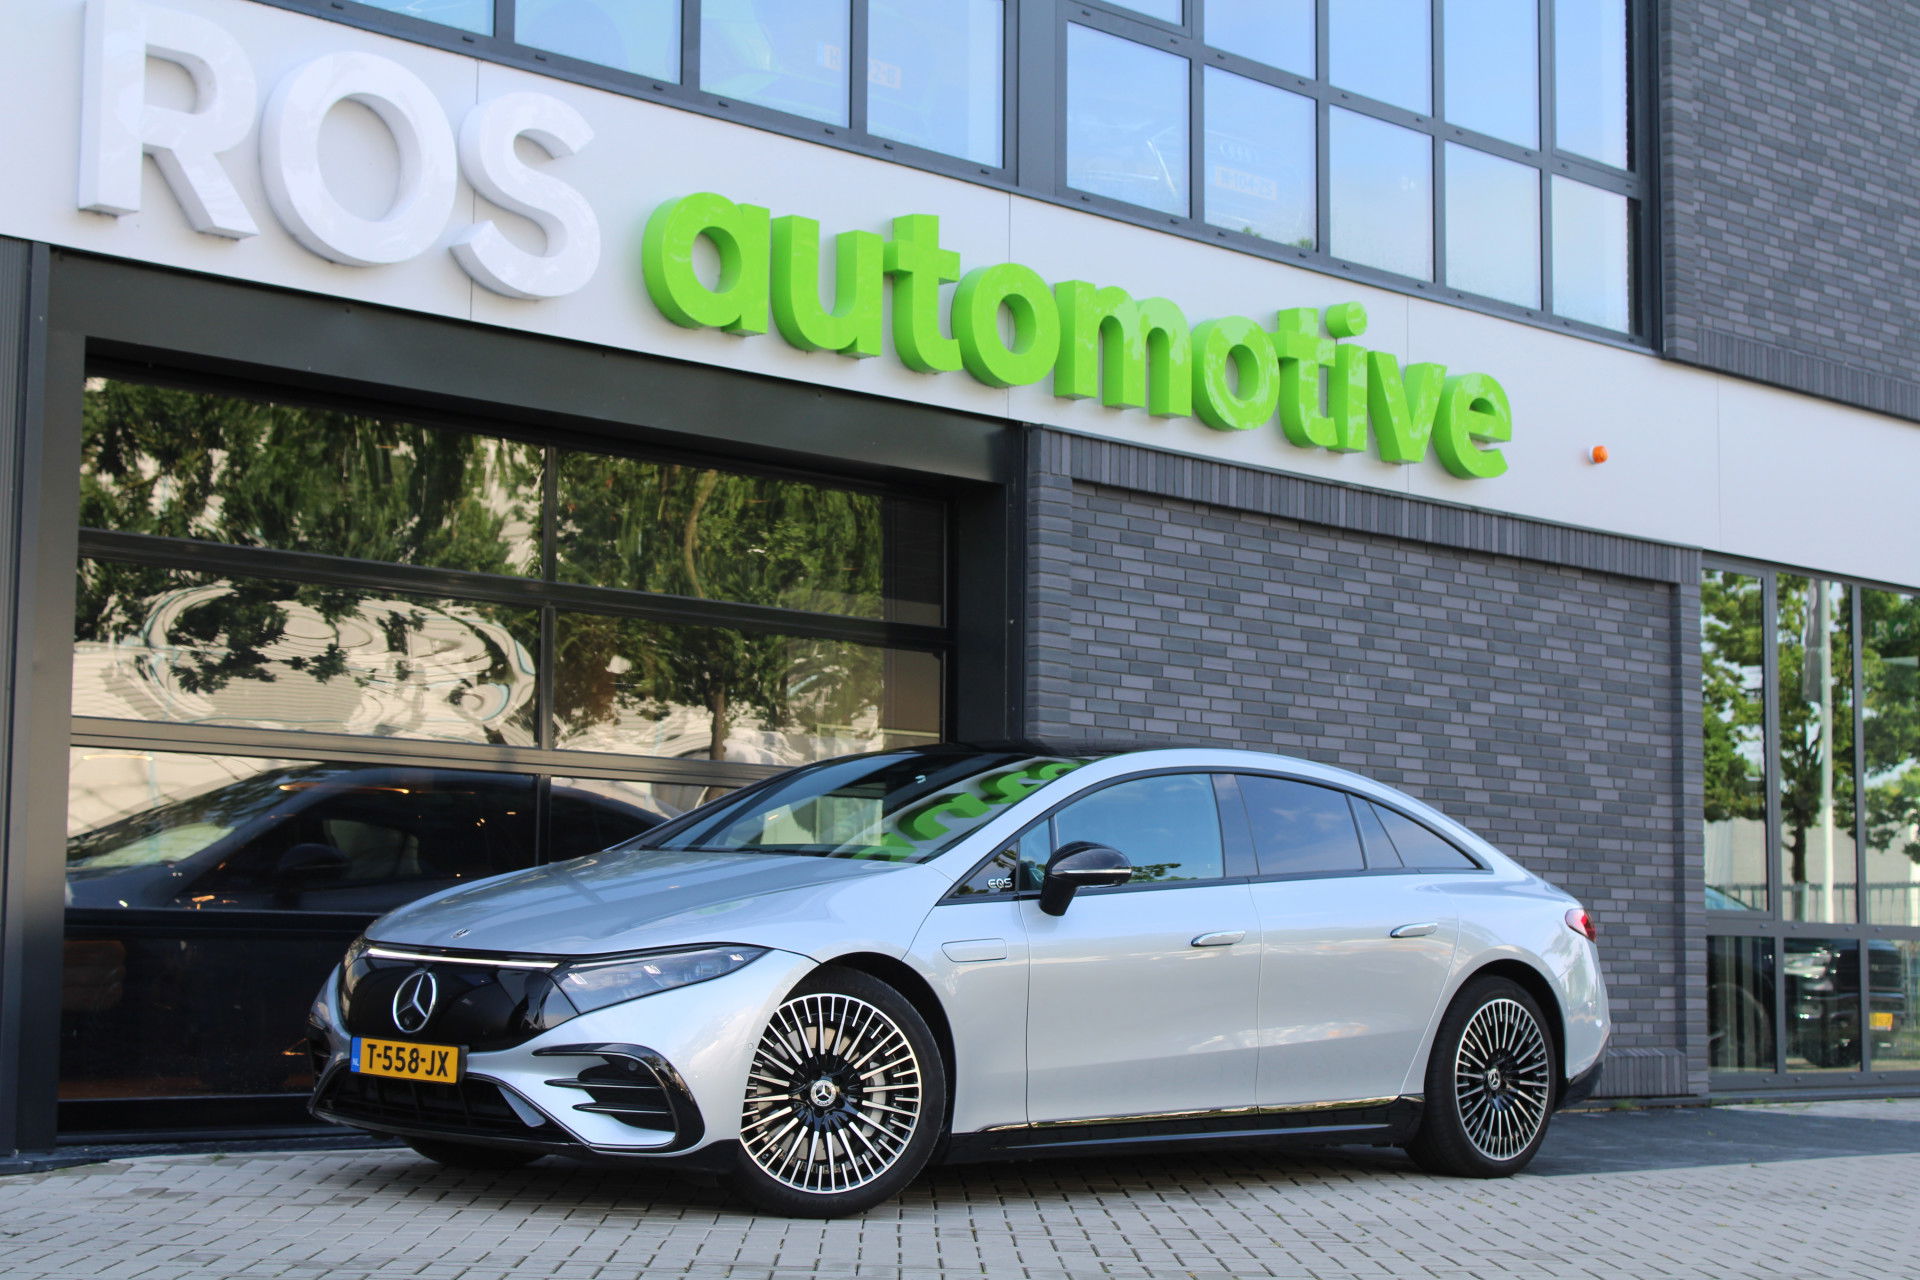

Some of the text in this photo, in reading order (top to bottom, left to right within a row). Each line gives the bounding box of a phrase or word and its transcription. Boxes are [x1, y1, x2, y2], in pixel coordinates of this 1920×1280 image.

[79, 0, 1512, 477] ROS automotive
[988, 878, 1012, 888] EQS
[367, 1043, 449, 1077] T-558-JX
